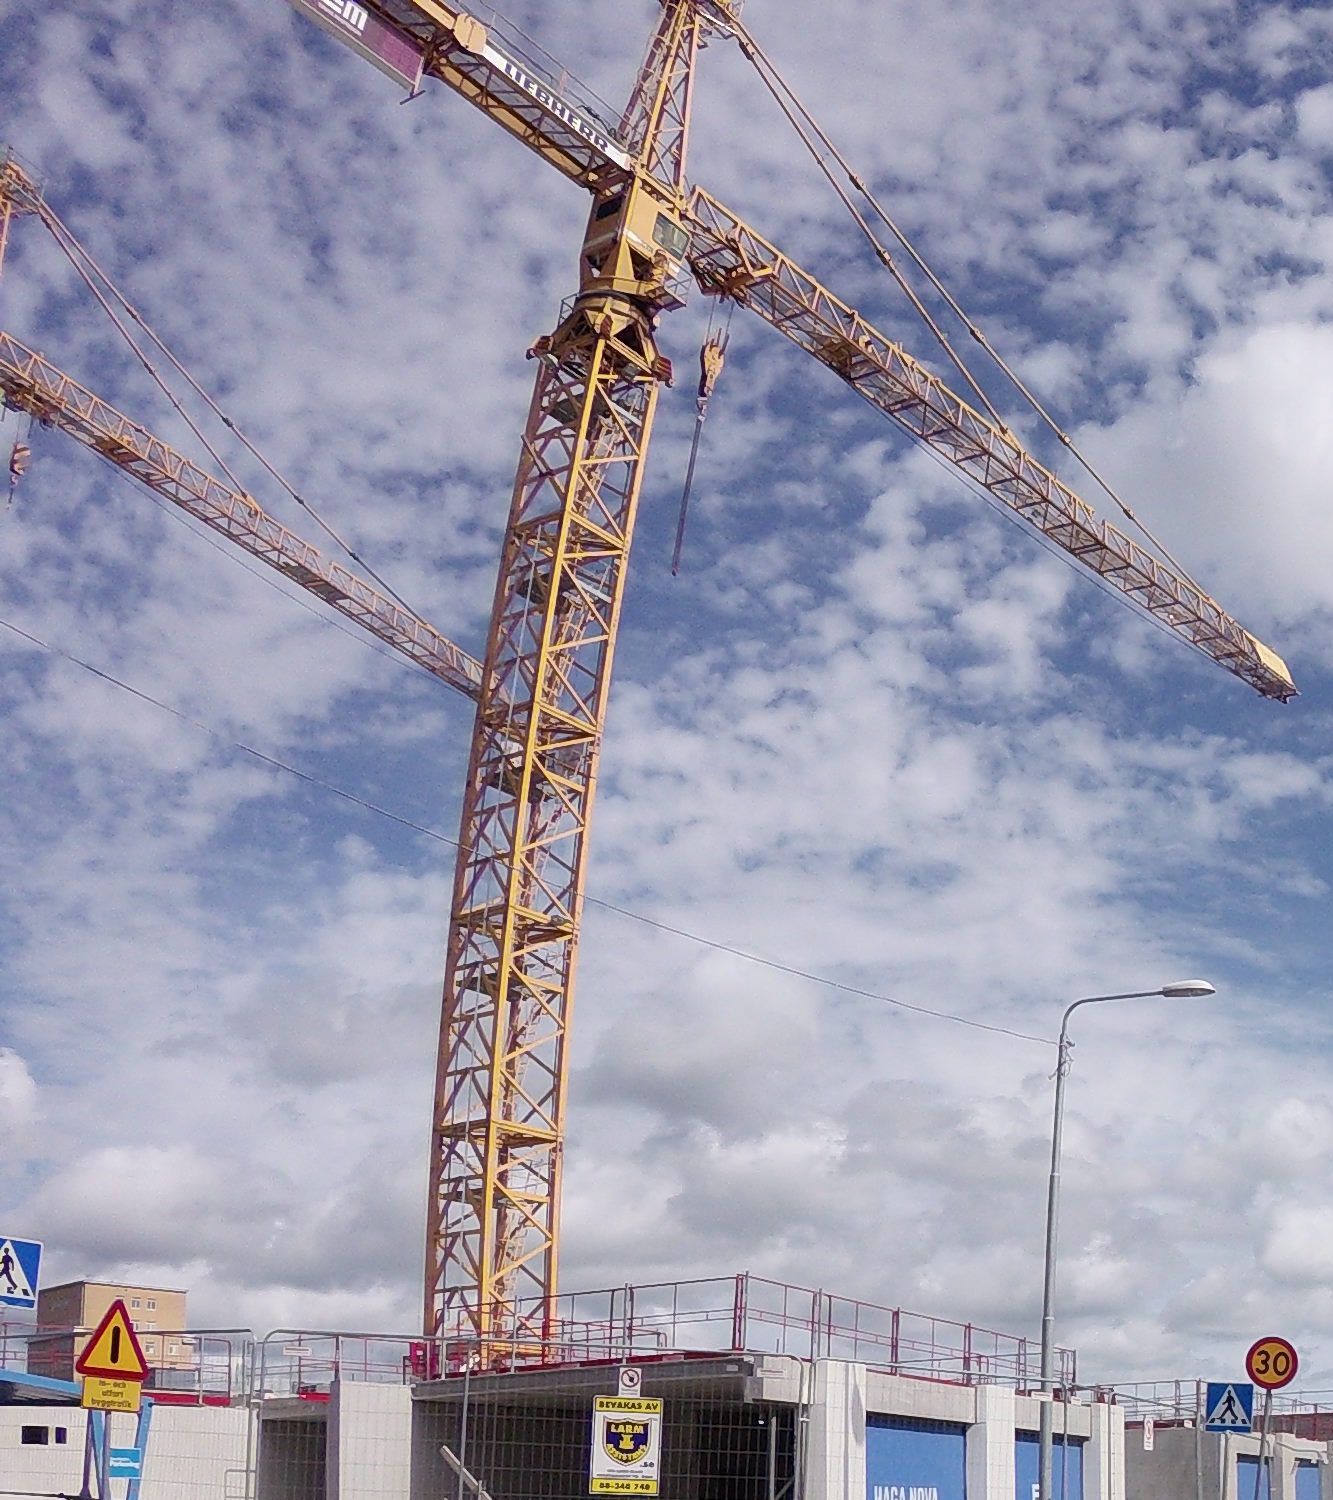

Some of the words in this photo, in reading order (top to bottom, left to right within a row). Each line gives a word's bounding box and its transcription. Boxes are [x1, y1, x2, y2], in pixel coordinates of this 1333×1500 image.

[504, 60, 609, 153] LIEBHERR
[1255, 1349, 1290, 1377] 30
[598, 1400, 643, 1410] BEVAKAS
[644, 1402, 659, 1411] AV
[610, 1423, 645, 1434] LARM
